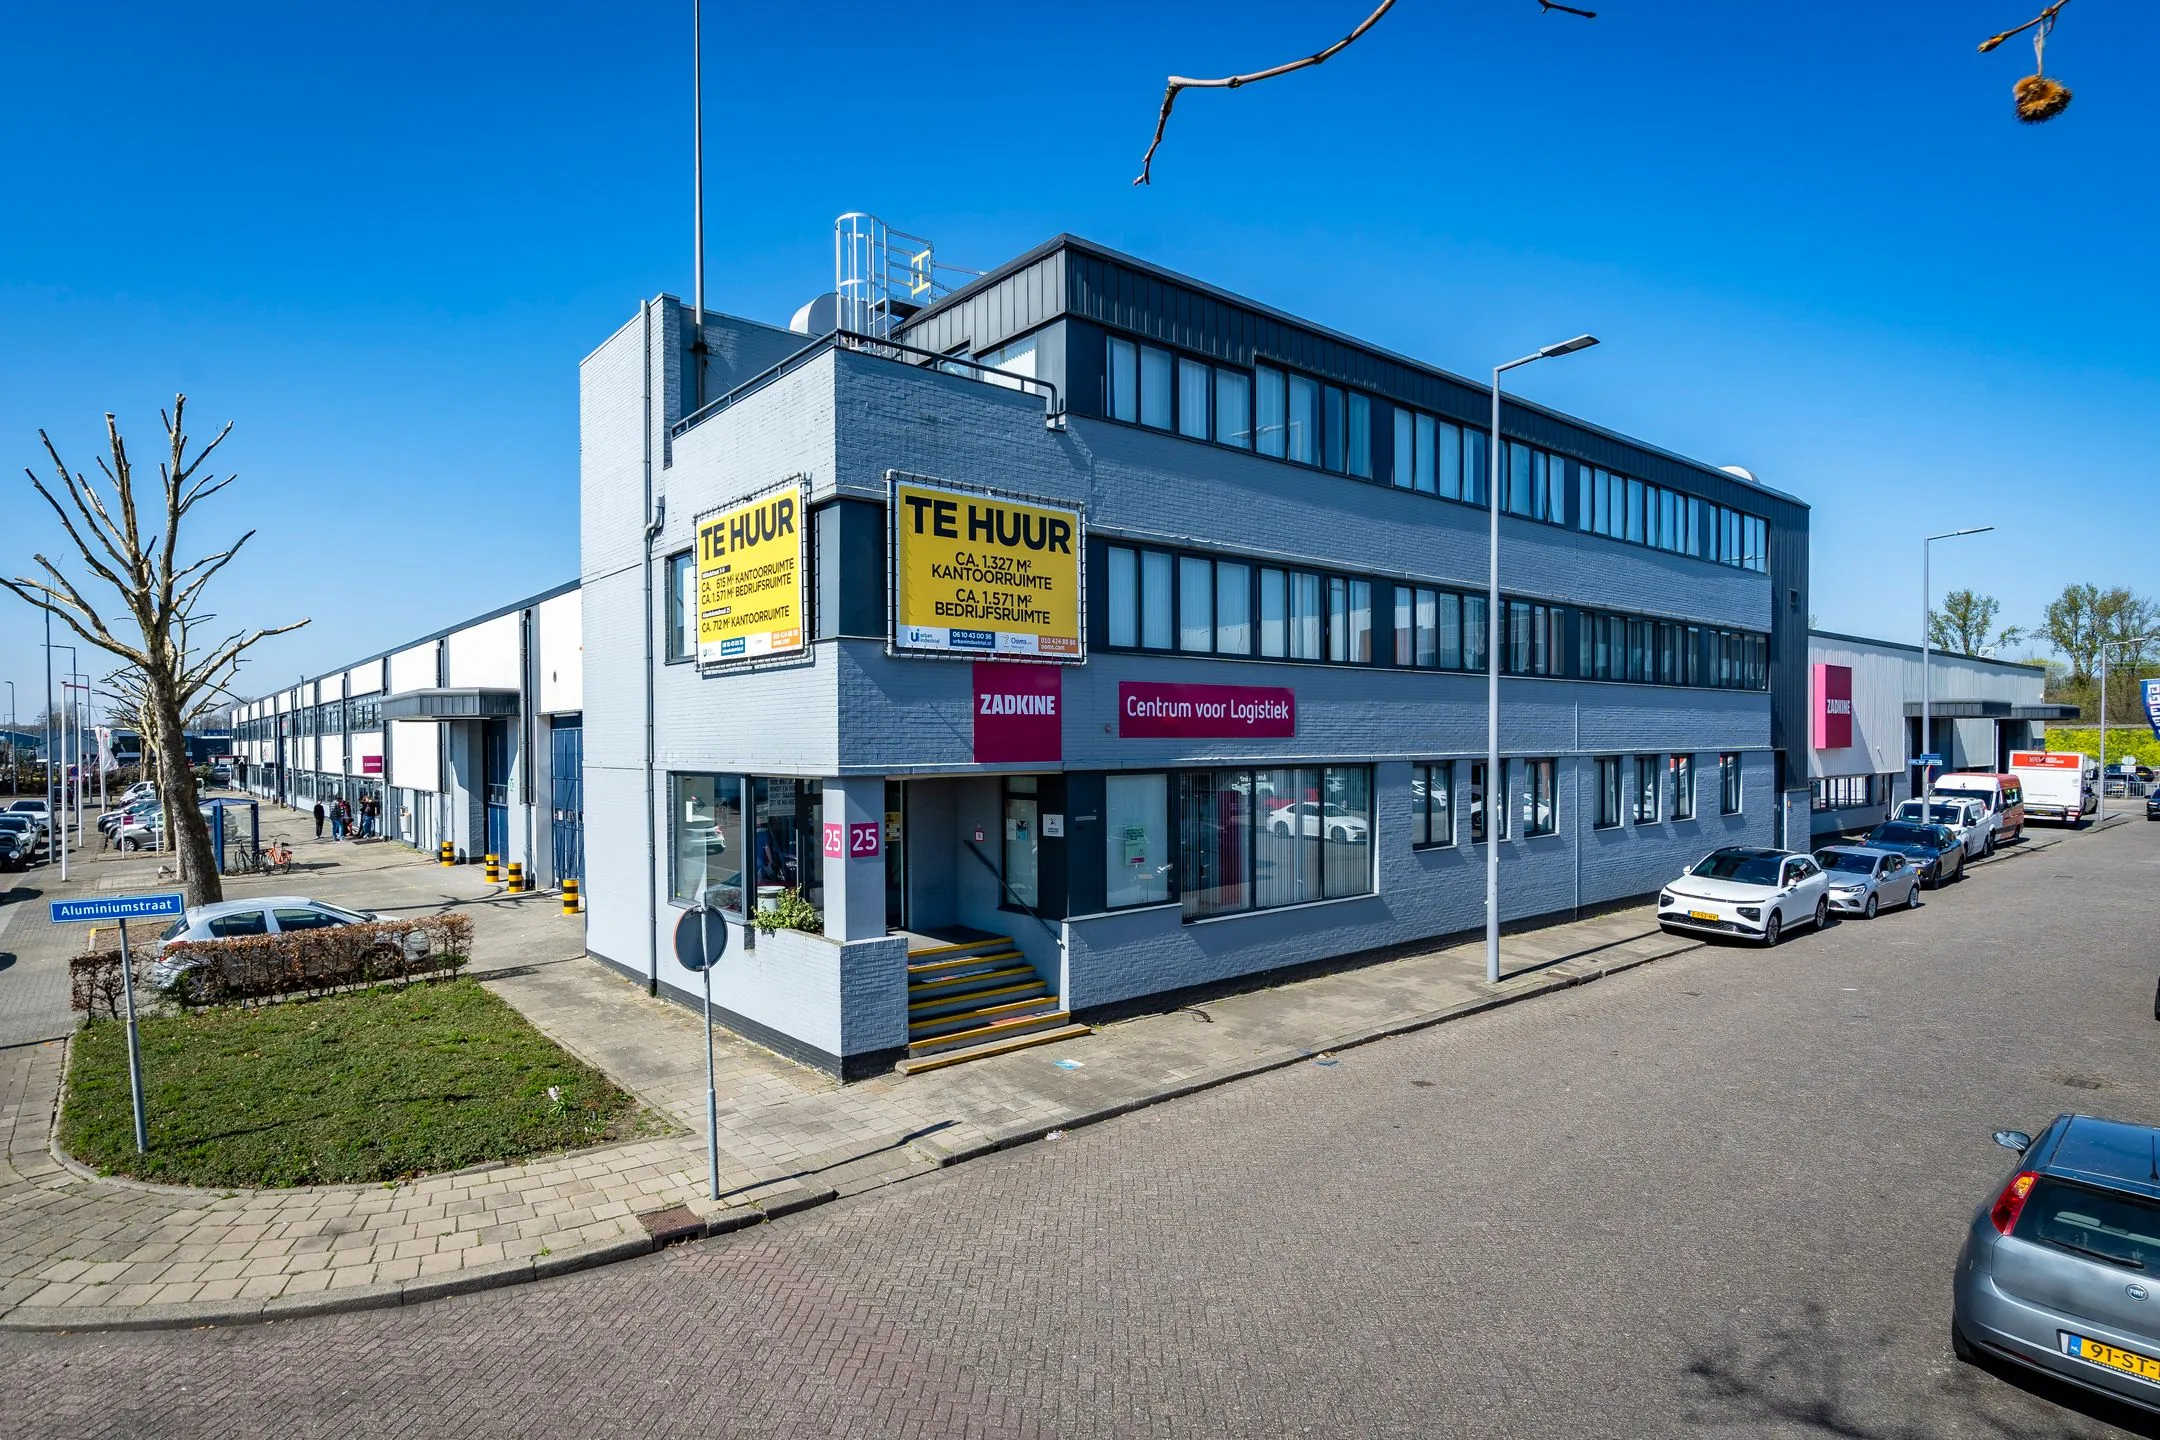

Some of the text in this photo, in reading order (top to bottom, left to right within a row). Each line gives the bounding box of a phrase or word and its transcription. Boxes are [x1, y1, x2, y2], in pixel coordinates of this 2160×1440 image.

[701, 498, 794, 560] TE HUUR
[905, 495, 1071, 554] TE HUUR
[955, 552, 1032, 573] CA. 1.327 M²
[702, 582, 711, 592] CA.
[735, 558, 794, 584] KANTOORRUIMTE
[931, 563, 1053, 590] KANTOORRUIMTE
[702, 595, 711, 605] CA.
[712, 590, 726, 602] 1.571
[735, 573, 791, 597] BEDRIJFSRUIMTE
[956, 589, 1032, 608] CA. 1.571 M²
[702, 622, 711, 632] CA.
[713, 620, 722, 631] 712
[731, 605, 789, 628] KANTOORRUIMTE
[935, 602, 1050, 624] BEDRIJFSRUIMTE
[1011, 637, 1027, 645] Ooms
[980, 694, 1055, 715] ZADKINE
[1127, 695, 1288, 724] Centrum voor Logistiek
[1827, 699, 1850, 714] ZADKINE
[825, 829, 841, 851] 25
[852, 829, 877, 851] 25
[61, 900, 172, 916] Aluminiumstraat
[2130, 1288, 2144, 1297] FIAT
[2090, 1344, 2160, 1378] 91-ST-
